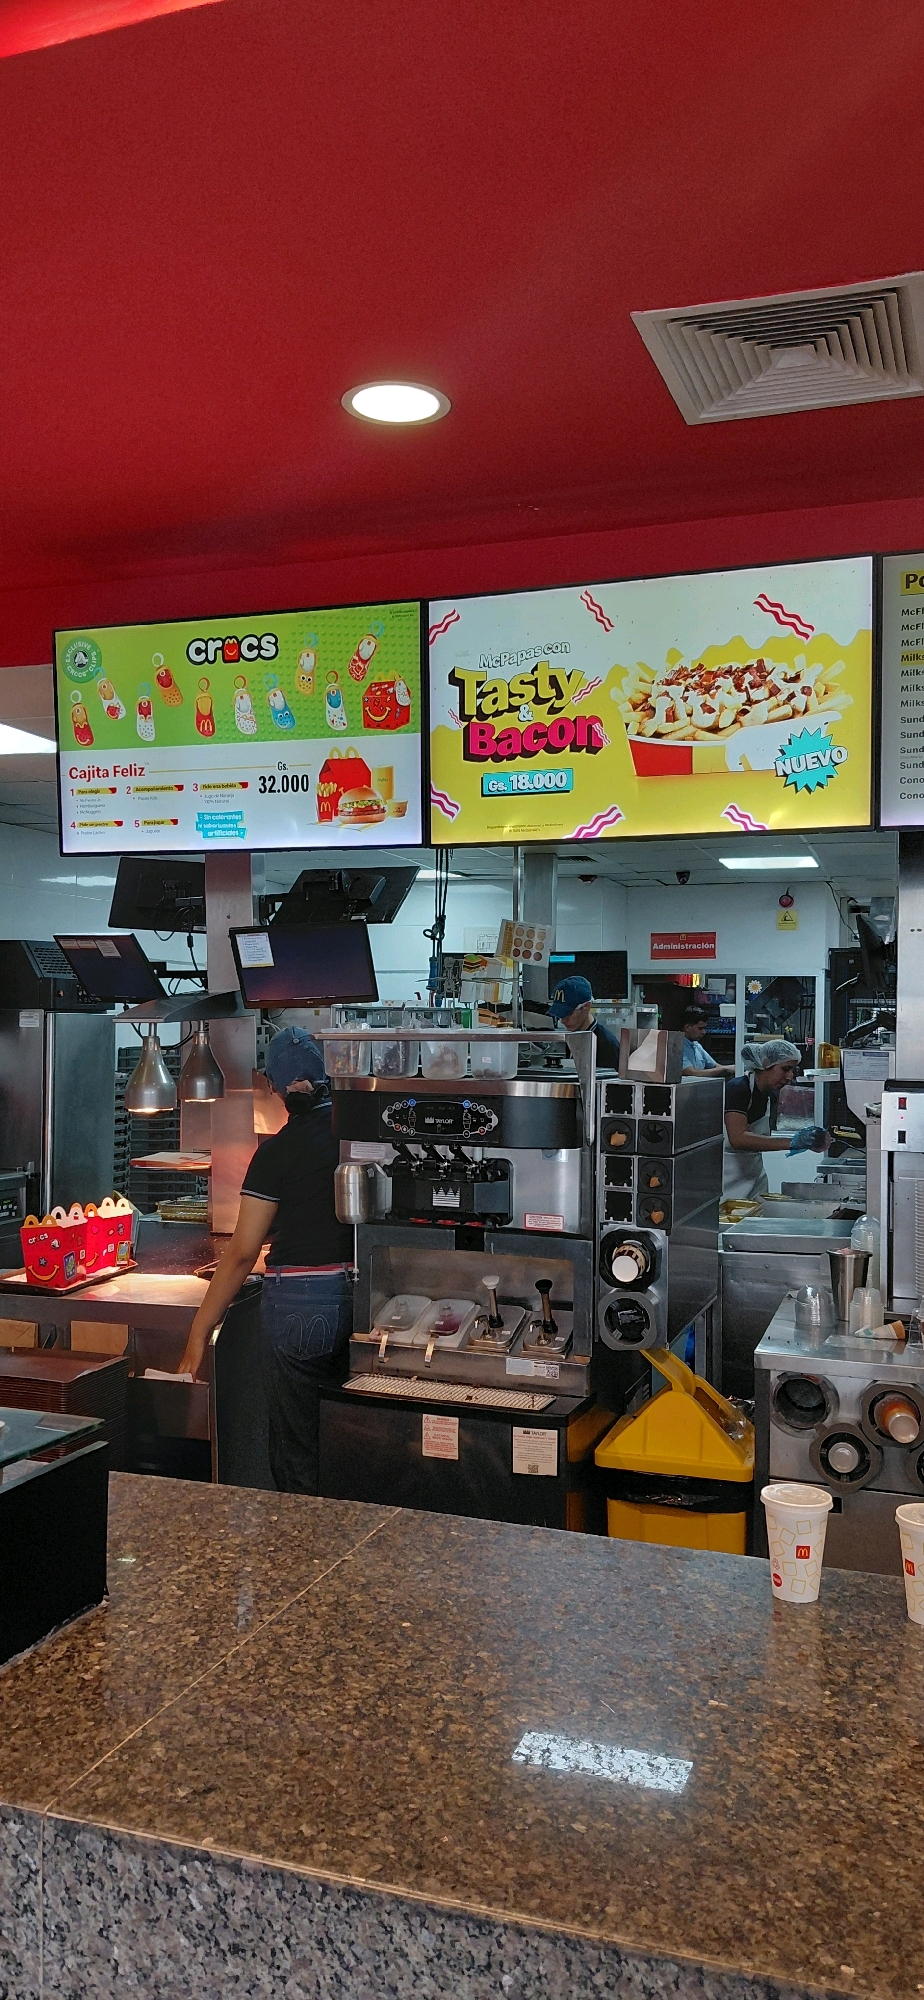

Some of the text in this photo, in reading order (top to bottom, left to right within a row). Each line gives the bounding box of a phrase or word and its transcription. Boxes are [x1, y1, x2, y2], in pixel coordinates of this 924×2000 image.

[479, 642, 570, 668] McPapas con
[450, 660, 585, 721] Tasty
[518, 704, 533, 722] &
[900, 714, 924, 724] Sund
[464, 715, 604, 762] Bacon
[900, 730, 924, 739] Sund
[900, 746, 924, 754] Sund
[278, 761, 288, 771] Gs.
[775, 746, 848, 777] NUEVO
[900, 761, 924, 770] Sund
[69, 763, 145, 782] Cajita Feliz
[259, 774, 309, 794] 32.000
[488, 771, 567, 792] Gs. 18.000
[900, 776, 924, 785] Cono
[70, 788, 74, 797] 1
[126, 785, 131, 795] 2
[192, 783, 198, 792] 3
[900, 792, 924, 800] Cono
[70, 821, 76, 829] 4
[134, 819, 140, 828] 5
[652, 942, 715, 950] Administración
[28, 1232, 49, 1244] crcs
